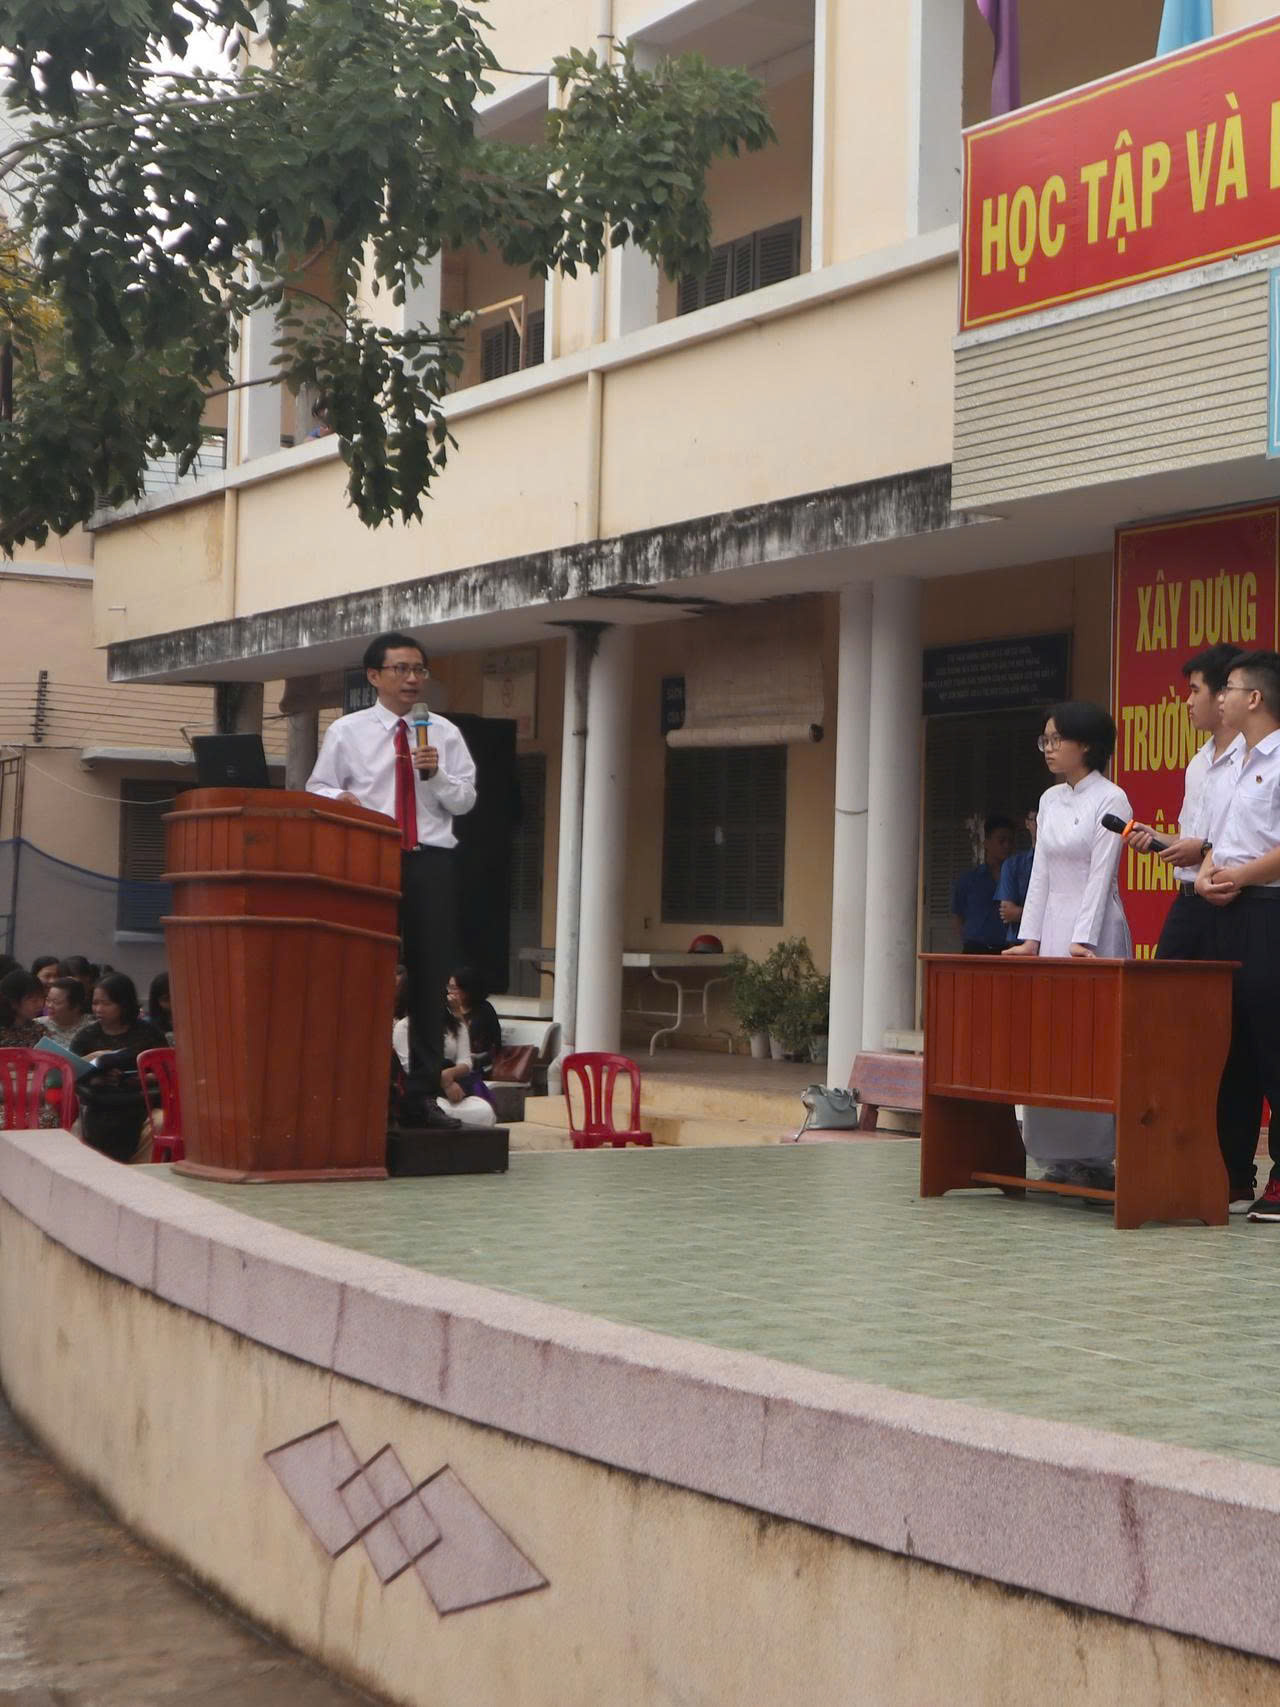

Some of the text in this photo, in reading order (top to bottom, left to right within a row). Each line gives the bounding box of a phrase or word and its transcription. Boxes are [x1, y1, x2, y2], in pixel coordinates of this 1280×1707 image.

[981, 175, 1067, 282] HỌC
[1081, 130, 1171, 253] TẬP
[1186, 91, 1248, 213] VÀ
[1136, 569, 1182, 652] XÂY
